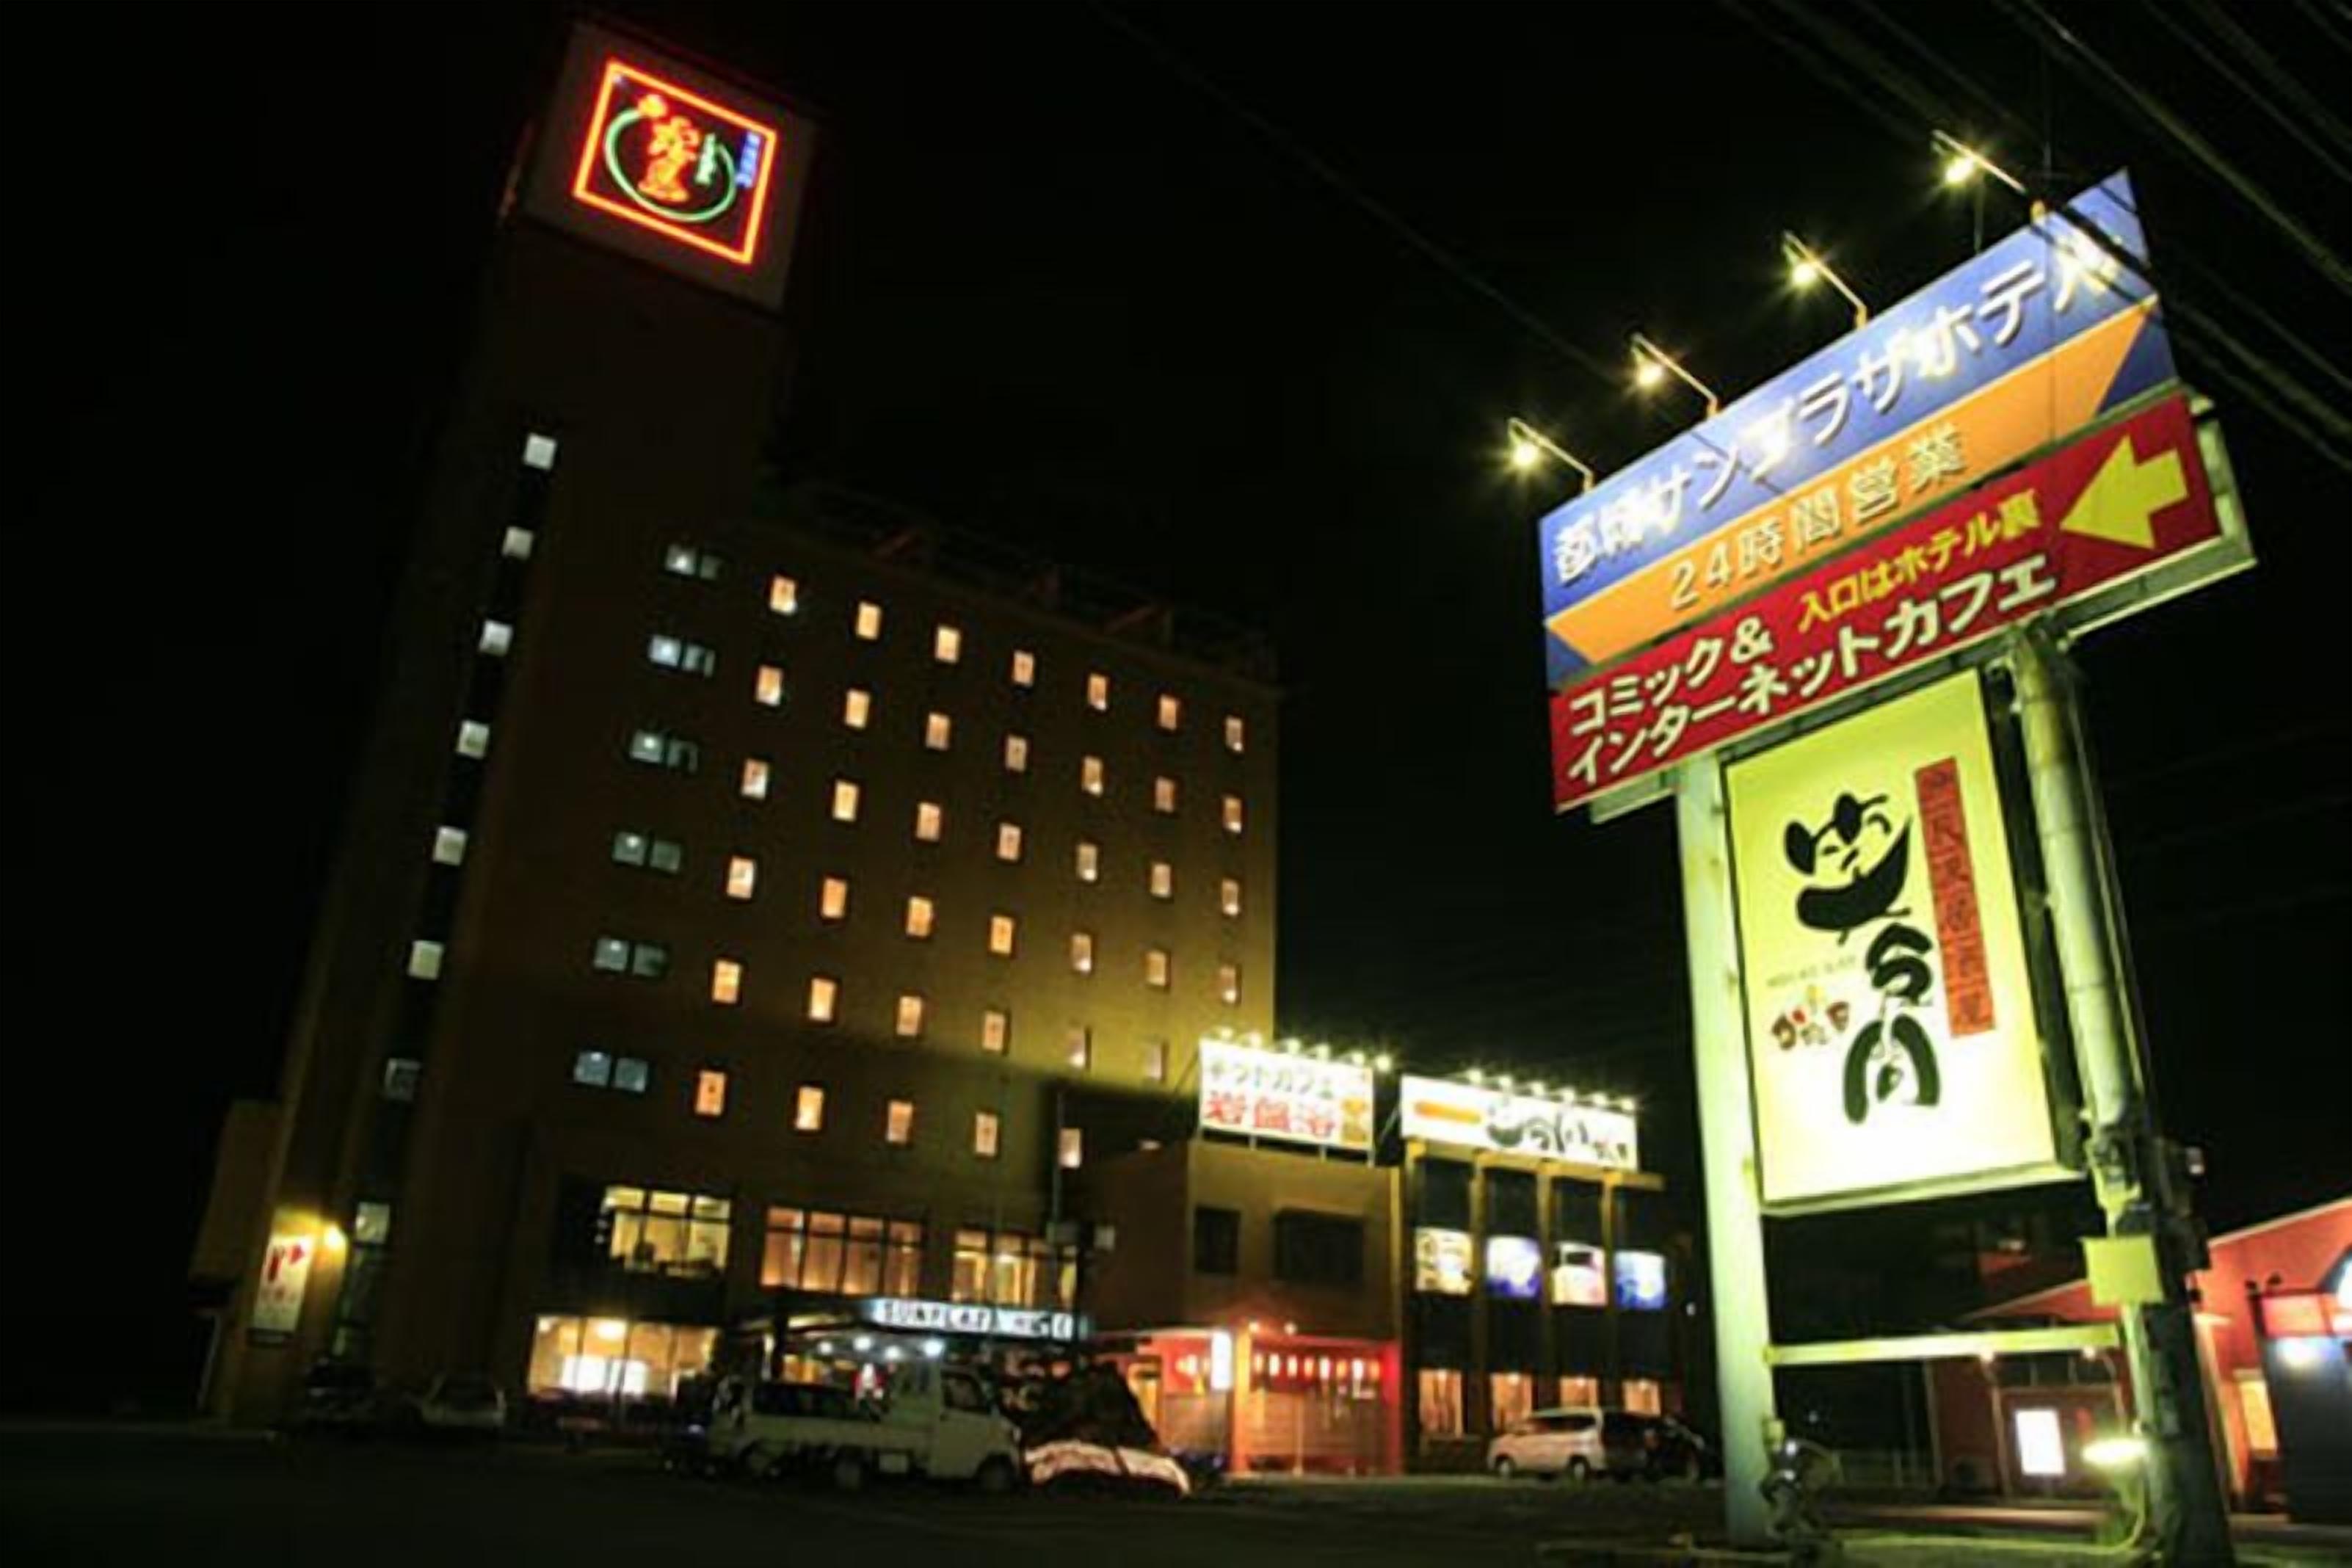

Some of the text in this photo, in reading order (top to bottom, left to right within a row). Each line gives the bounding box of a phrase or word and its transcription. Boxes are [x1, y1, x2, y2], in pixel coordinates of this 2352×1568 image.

[1668, 423, 1969, 609] 24時間営業
[1567, 553, 2058, 786] インターネットカフェ
